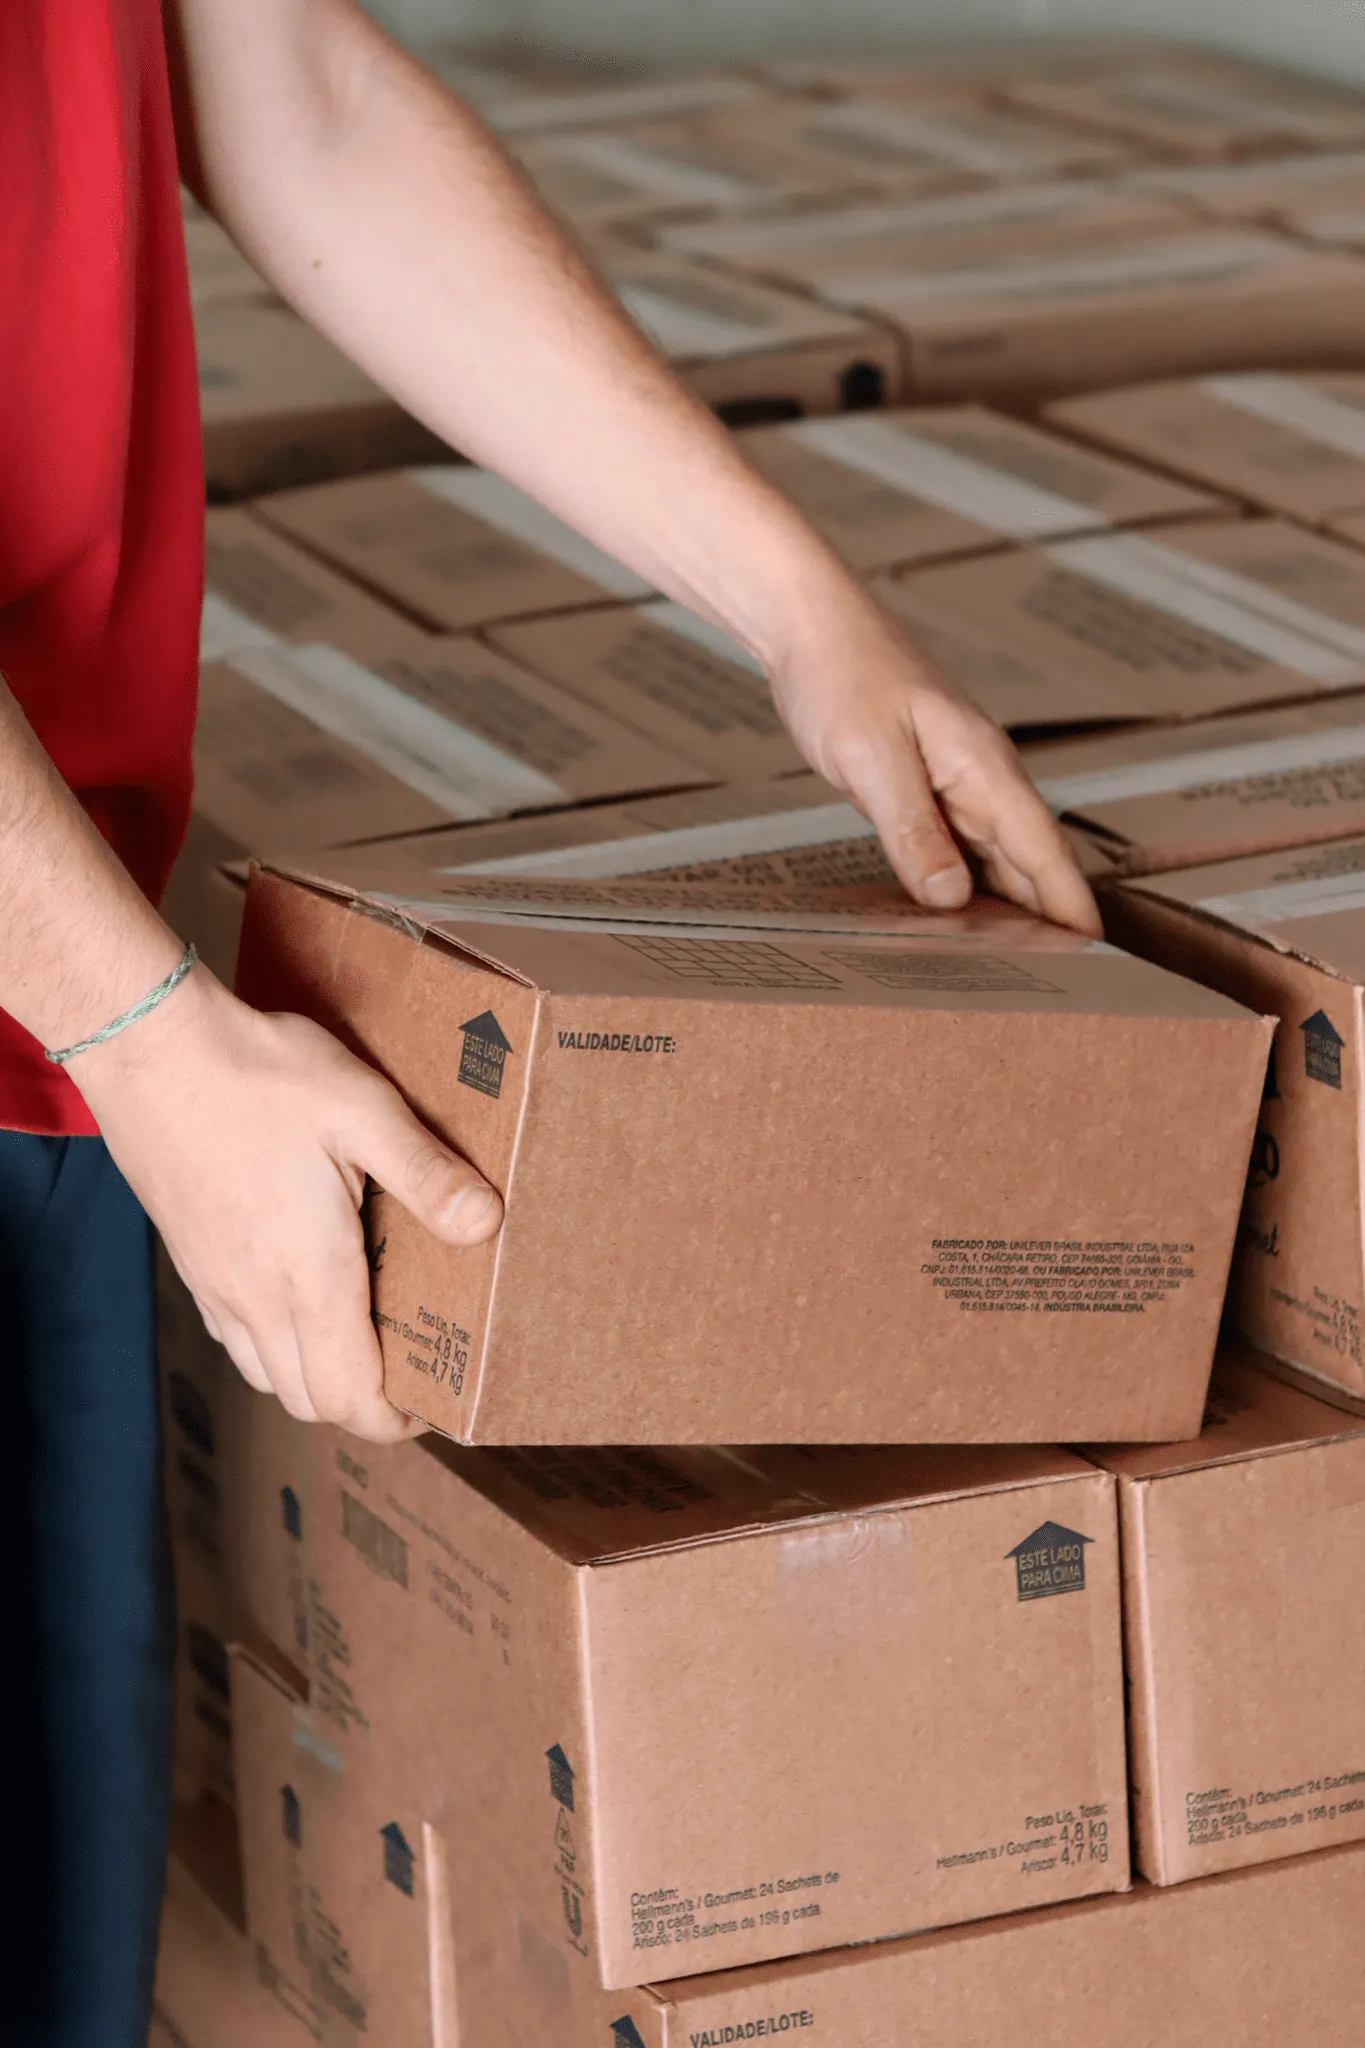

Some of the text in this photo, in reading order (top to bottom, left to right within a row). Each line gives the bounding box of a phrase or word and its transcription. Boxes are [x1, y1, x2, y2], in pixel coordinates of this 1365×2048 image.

[464, 1033, 505, 1065] ESTE LADO
[558, 1031, 676, 1054] VALIDADE/LOTE:
[462, 1054, 500, 1083] PARA CIMA
[931, 1239, 984, 1249] FABRICADO
[985, 1240, 1007, 1250] POR:
[1010, 1241, 1050, 1250] UNILEVER
[1033, 1266, 1047, 1275] OU
[1048, 1266, 1099, 1276] FABRICADO
[1062, 1253, 1079, 1264] CEP
[932, 1277, 984, 1287] INDUSTRIAL
[1025, 1278, 1066, 1288] PREFEITO
[984, 1290, 1004, 1300] CEP
[417, 1305, 435, 1328] Peso
[451, 1322, 472, 1346] Total:
[403, 1322, 433, 1352] Gourmet:
[434, 1335, 451, 1361] 4,8
[453, 1343, 468, 1373] kg
[406, 1351, 464, 1396] Arisco: 4,7 kg
[1019, 1544, 1081, 1570] ESTE LADO
[1021, 1564, 1081, 1590] PARA CIMA
[1025, 1815, 1053, 1830] Peso
[1187, 1811, 1248, 1833] 200 g cada
[1228, 1826, 1242, 1839] 24
[1244, 1815, 1287, 1835] Sachets
[1290, 1812, 1304, 1825] de
[1328, 1806, 1337, 1819] g
[1339, 1797, 1365, 1814] cada
[936, 1847, 997, 1869] Hellmann's
[1006, 1835, 1056, 1856] Gourmet:
[1059, 1822, 1084, 1846] 4,8
[1088, 1819, 1108, 1842] kg
[1020, 1841, 1109, 1874] Arisco: 4,7 kg
[630, 1888, 679, 1907] Contém:
[631, 1898, 694, 1921] Hellmann's
[704, 1887, 757, 1908] Gourmet:
[759, 1883, 774, 1897] 24
[777, 1872, 822, 1893] Sachets
[824, 1870, 840, 1885] de
[632, 1913, 695, 1936] 200 g cada
[633, 1933, 672, 1949] Arisco:
[675, 1928, 690, 1943] 24
[692, 1918, 738, 1940] Sachets
[740, 1917, 755, 1930] de
[782, 1911, 790, 1925] g
[792, 1902, 821, 1920] cada
[690, 2009, 814, 2048] VALIDADE/LOTE:
